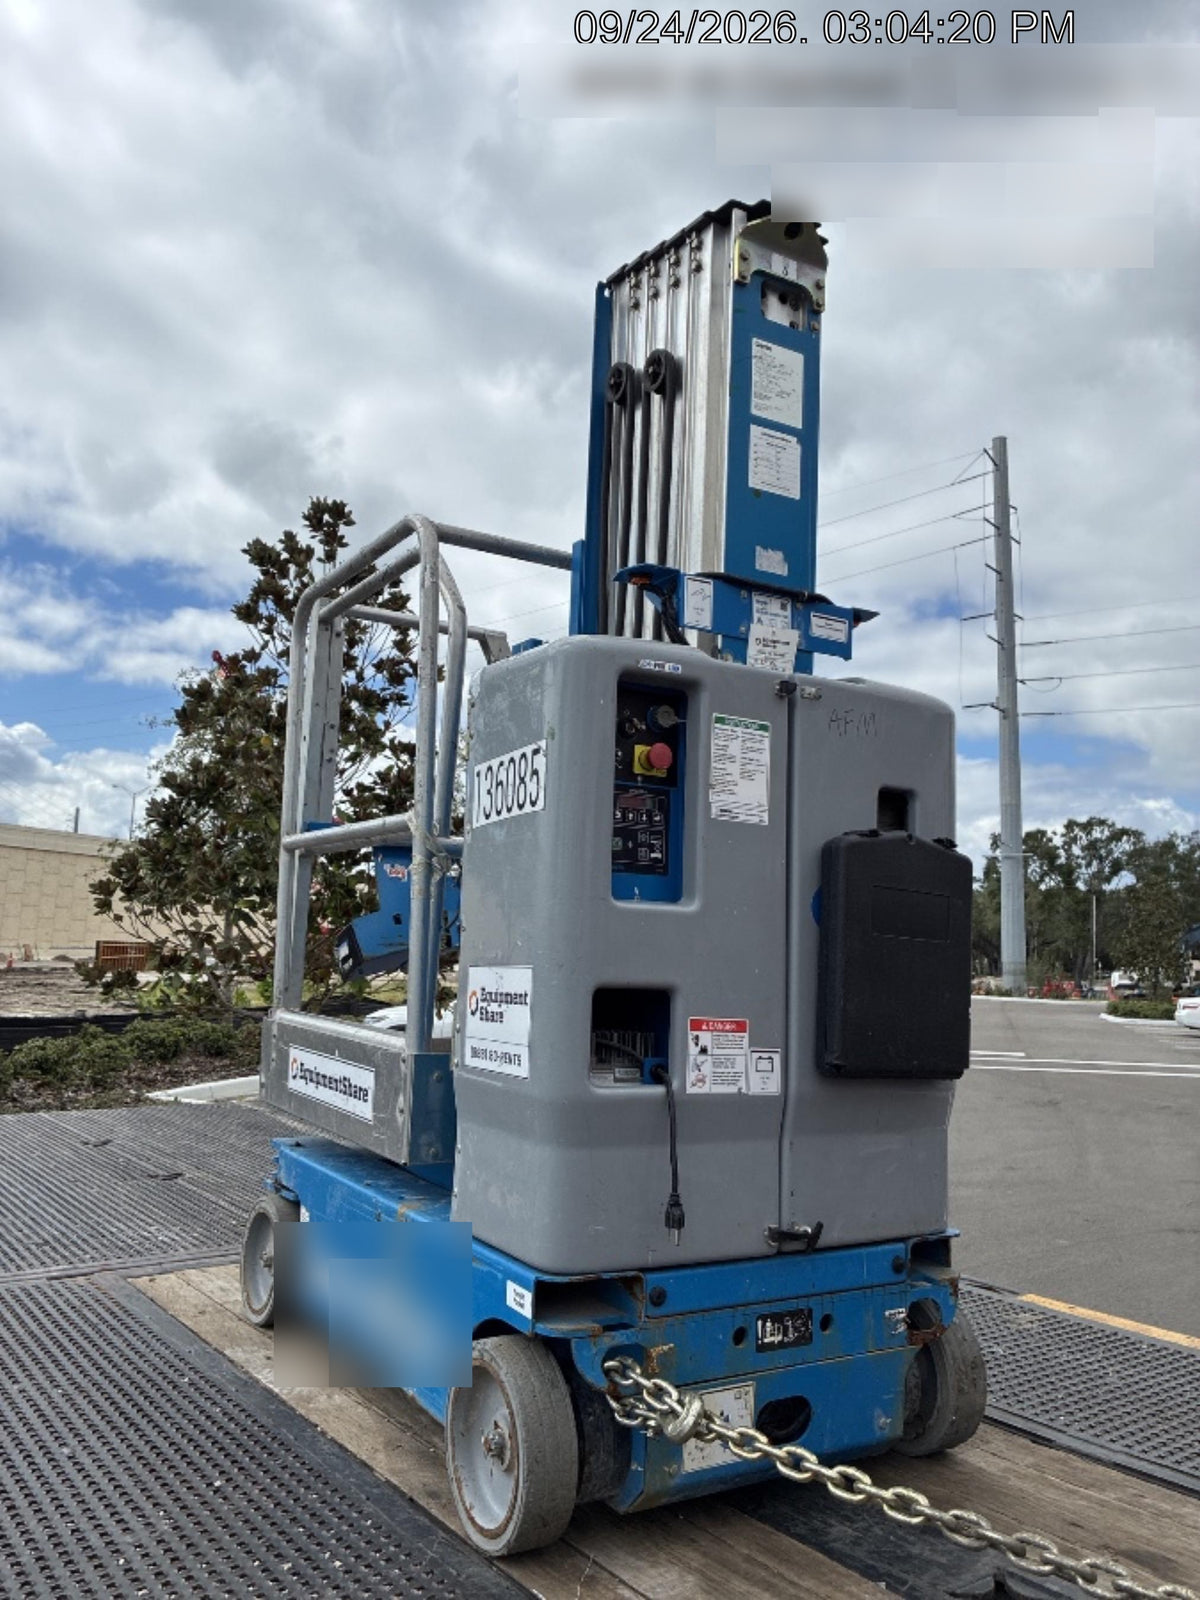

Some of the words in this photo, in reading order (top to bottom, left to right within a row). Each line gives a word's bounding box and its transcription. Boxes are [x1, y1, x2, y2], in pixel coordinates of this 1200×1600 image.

[480, 987, 528, 1007] Equipment
[479, 1005, 504, 1023] Share
[300, 1062, 368, 1103] EquipmentShare
